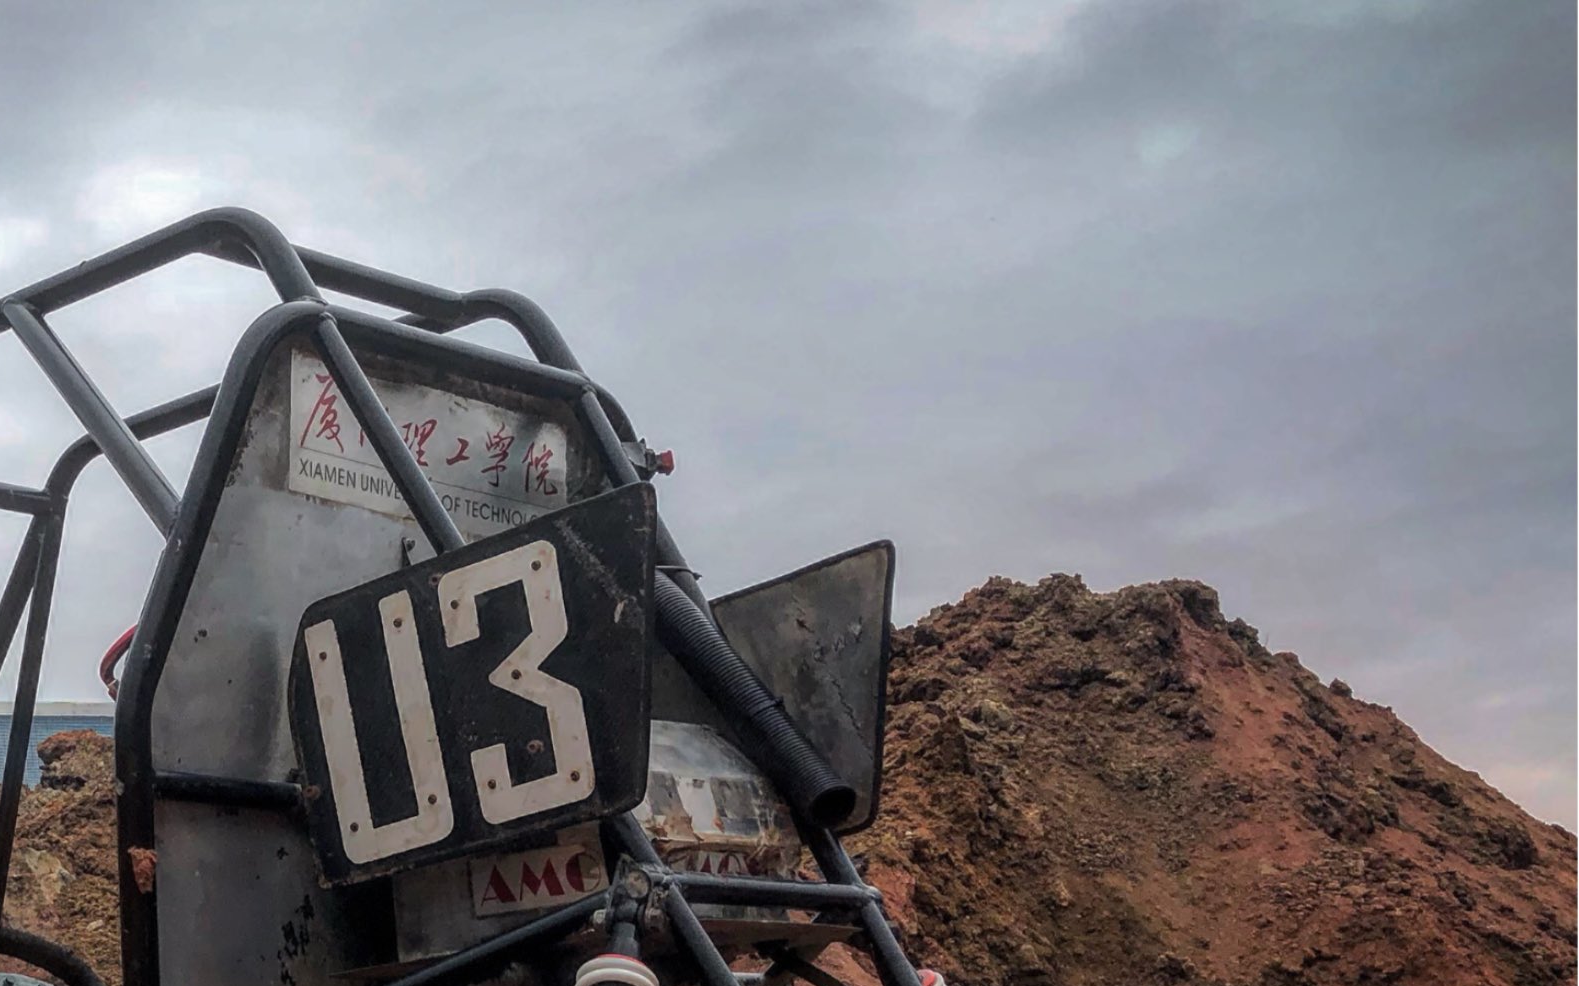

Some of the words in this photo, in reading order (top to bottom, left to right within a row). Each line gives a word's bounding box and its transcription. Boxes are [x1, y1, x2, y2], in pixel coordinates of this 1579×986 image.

[298, 457, 357, 489] XIAMEN
[441, 494, 460, 512] OF
[466, 500, 538, 526] TECHNO
[300, 373, 558, 496] 厦理工學院
[305, 540, 596, 864] U3
